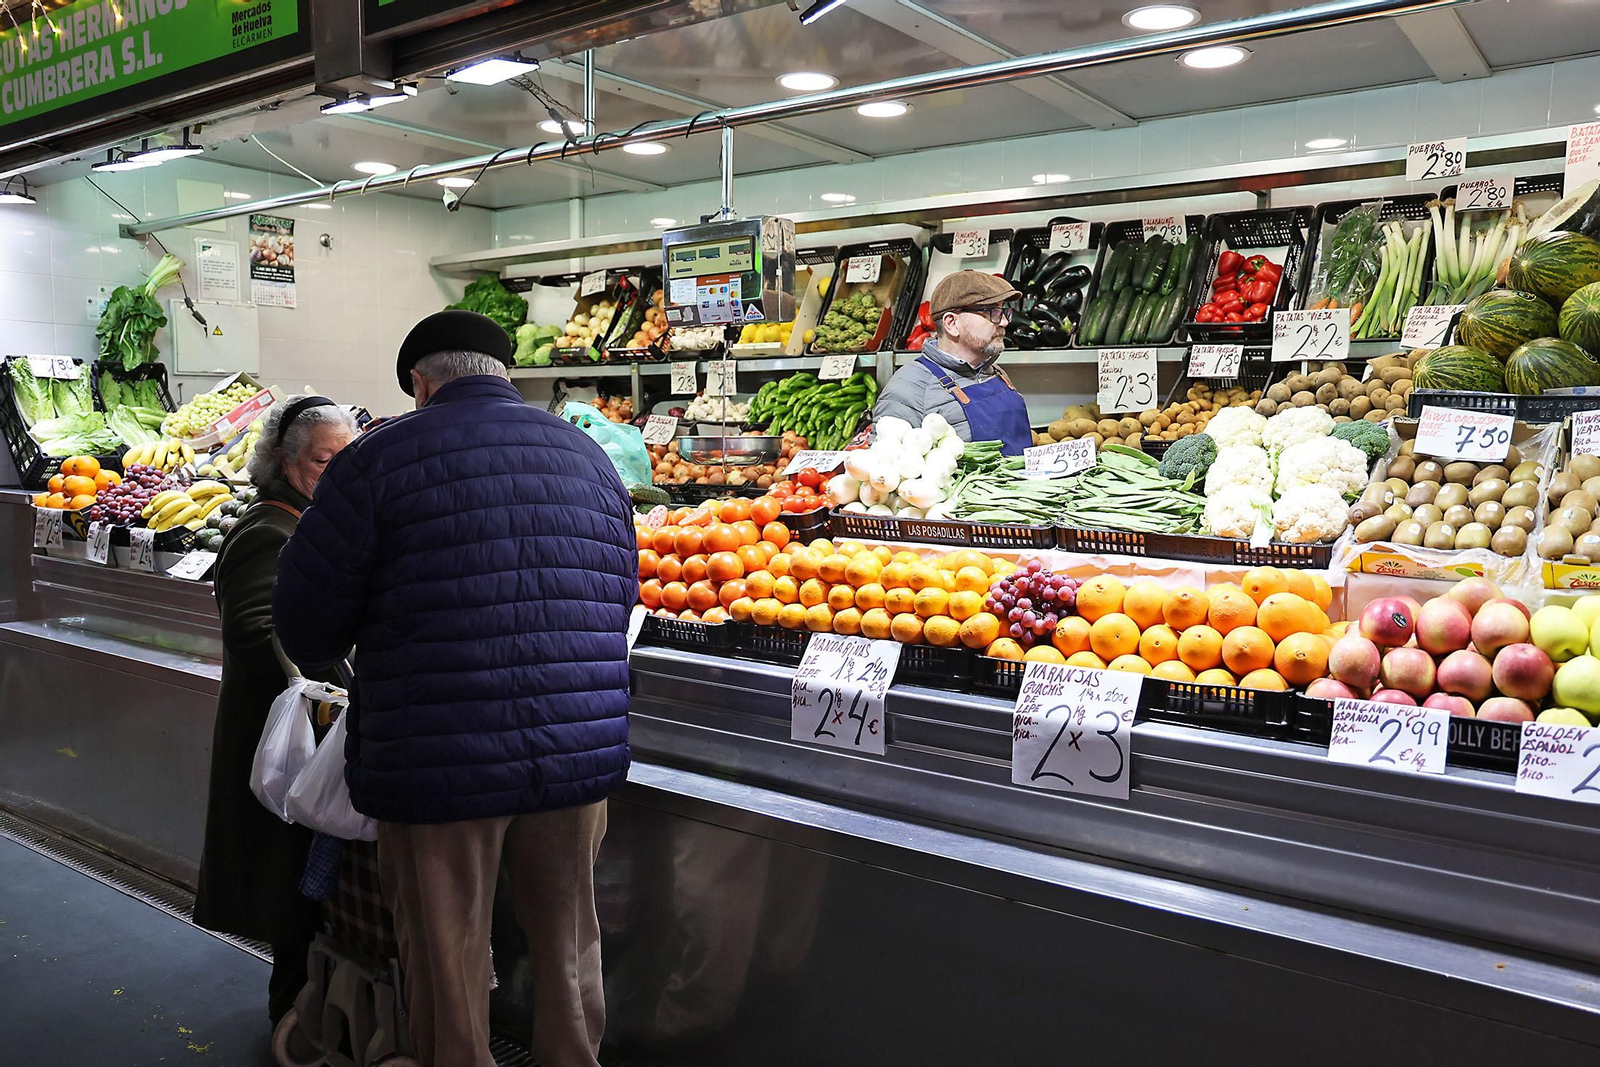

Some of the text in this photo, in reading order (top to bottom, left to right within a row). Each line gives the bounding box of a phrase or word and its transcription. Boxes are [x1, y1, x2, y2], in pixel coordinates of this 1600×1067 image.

[232, 2, 271, 24] Mercados
[232, 15, 272, 36] de Huelva
[2, 30, 163, 114] CUMBRERA S.L.
[1409, 142, 1445, 155] PUERROS
[1571, 138, 1581, 147] DE
[1459, 179, 1494, 190] PUERROS
[1060, 231, 1071, 248] 3
[862, 263, 871, 279] 3
[1276, 312, 1304, 322] PATATAS
[1290, 324, 1312, 359] 2
[1315, 323, 1338, 358] 2
[1101, 350, 1126, 361] PATATAS
[1115, 375, 1129, 409] 2
[1136, 372, 1152, 405] 3
[907, 525, 965, 540] LAS POSADILLAS
[1376, 565, 1406, 575] Zespri
[810, 636, 871, 658] MANDARINAS
[804, 655, 819, 665] DE
[795, 668, 821, 679] LEPE
[1028, 664, 1103, 687] NARANJAS
[1024, 695, 1039, 703] DE
[1016, 704, 1043, 714] LEPE
[1336, 700, 1389, 714] MANZANA
[814, 688, 836, 738] 2
[848, 690, 869, 745] 4
[867, 719, 879, 735] €
[1523, 723, 1590, 741] GOLDEN
[1031, 704, 1074, 786] 2
[1072, 705, 1086, 726] Kg
[1088, 710, 1124, 783] 3
[1121, 709, 1134, 722] €
[1399, 748, 1413, 761] €
